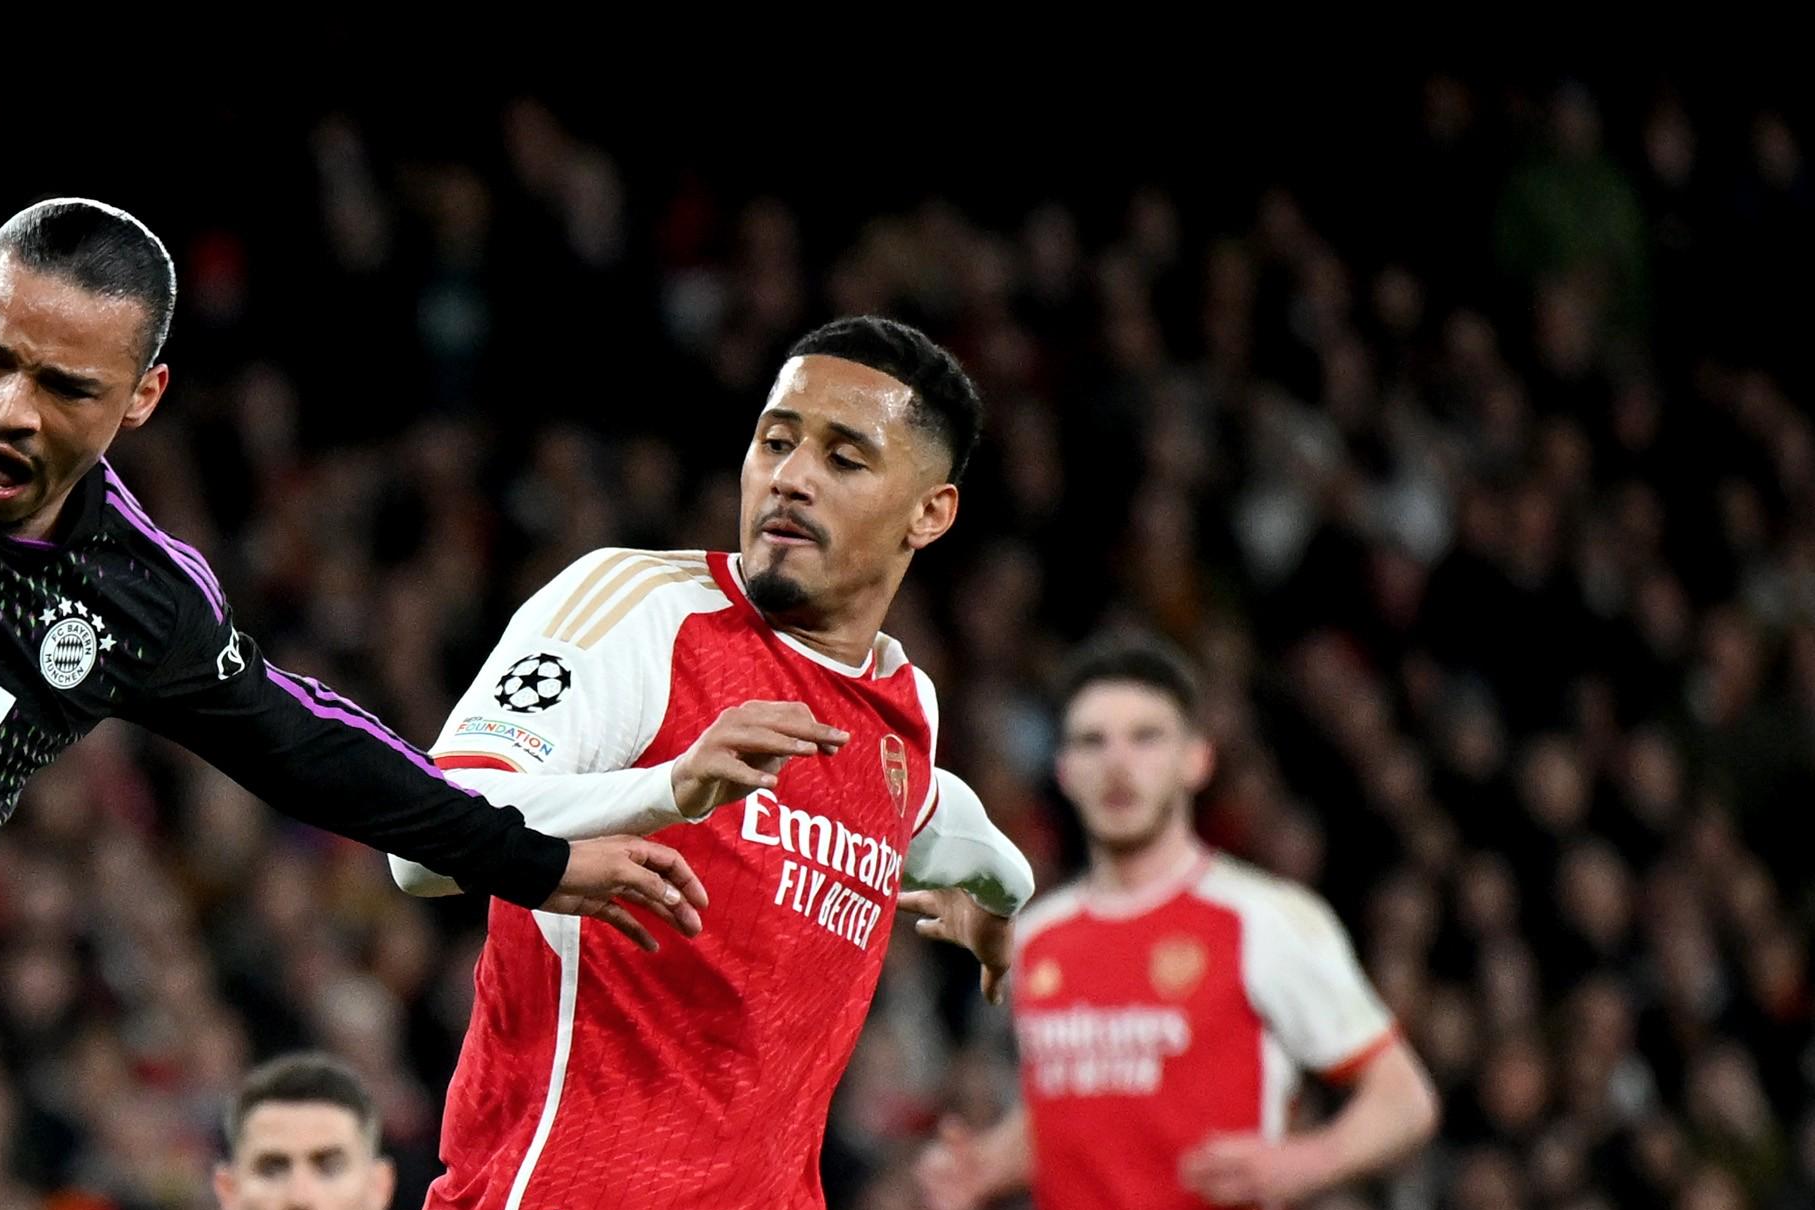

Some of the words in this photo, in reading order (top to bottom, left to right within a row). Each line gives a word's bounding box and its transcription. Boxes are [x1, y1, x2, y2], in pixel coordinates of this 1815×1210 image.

[51, 627, 65, 642] FC
[66, 624, 93, 656] BAYERN
[456, 722, 553, 756] FOUNDATION
[773, 859, 827, 919] FLY
[816, 880, 882, 951] BETTER
